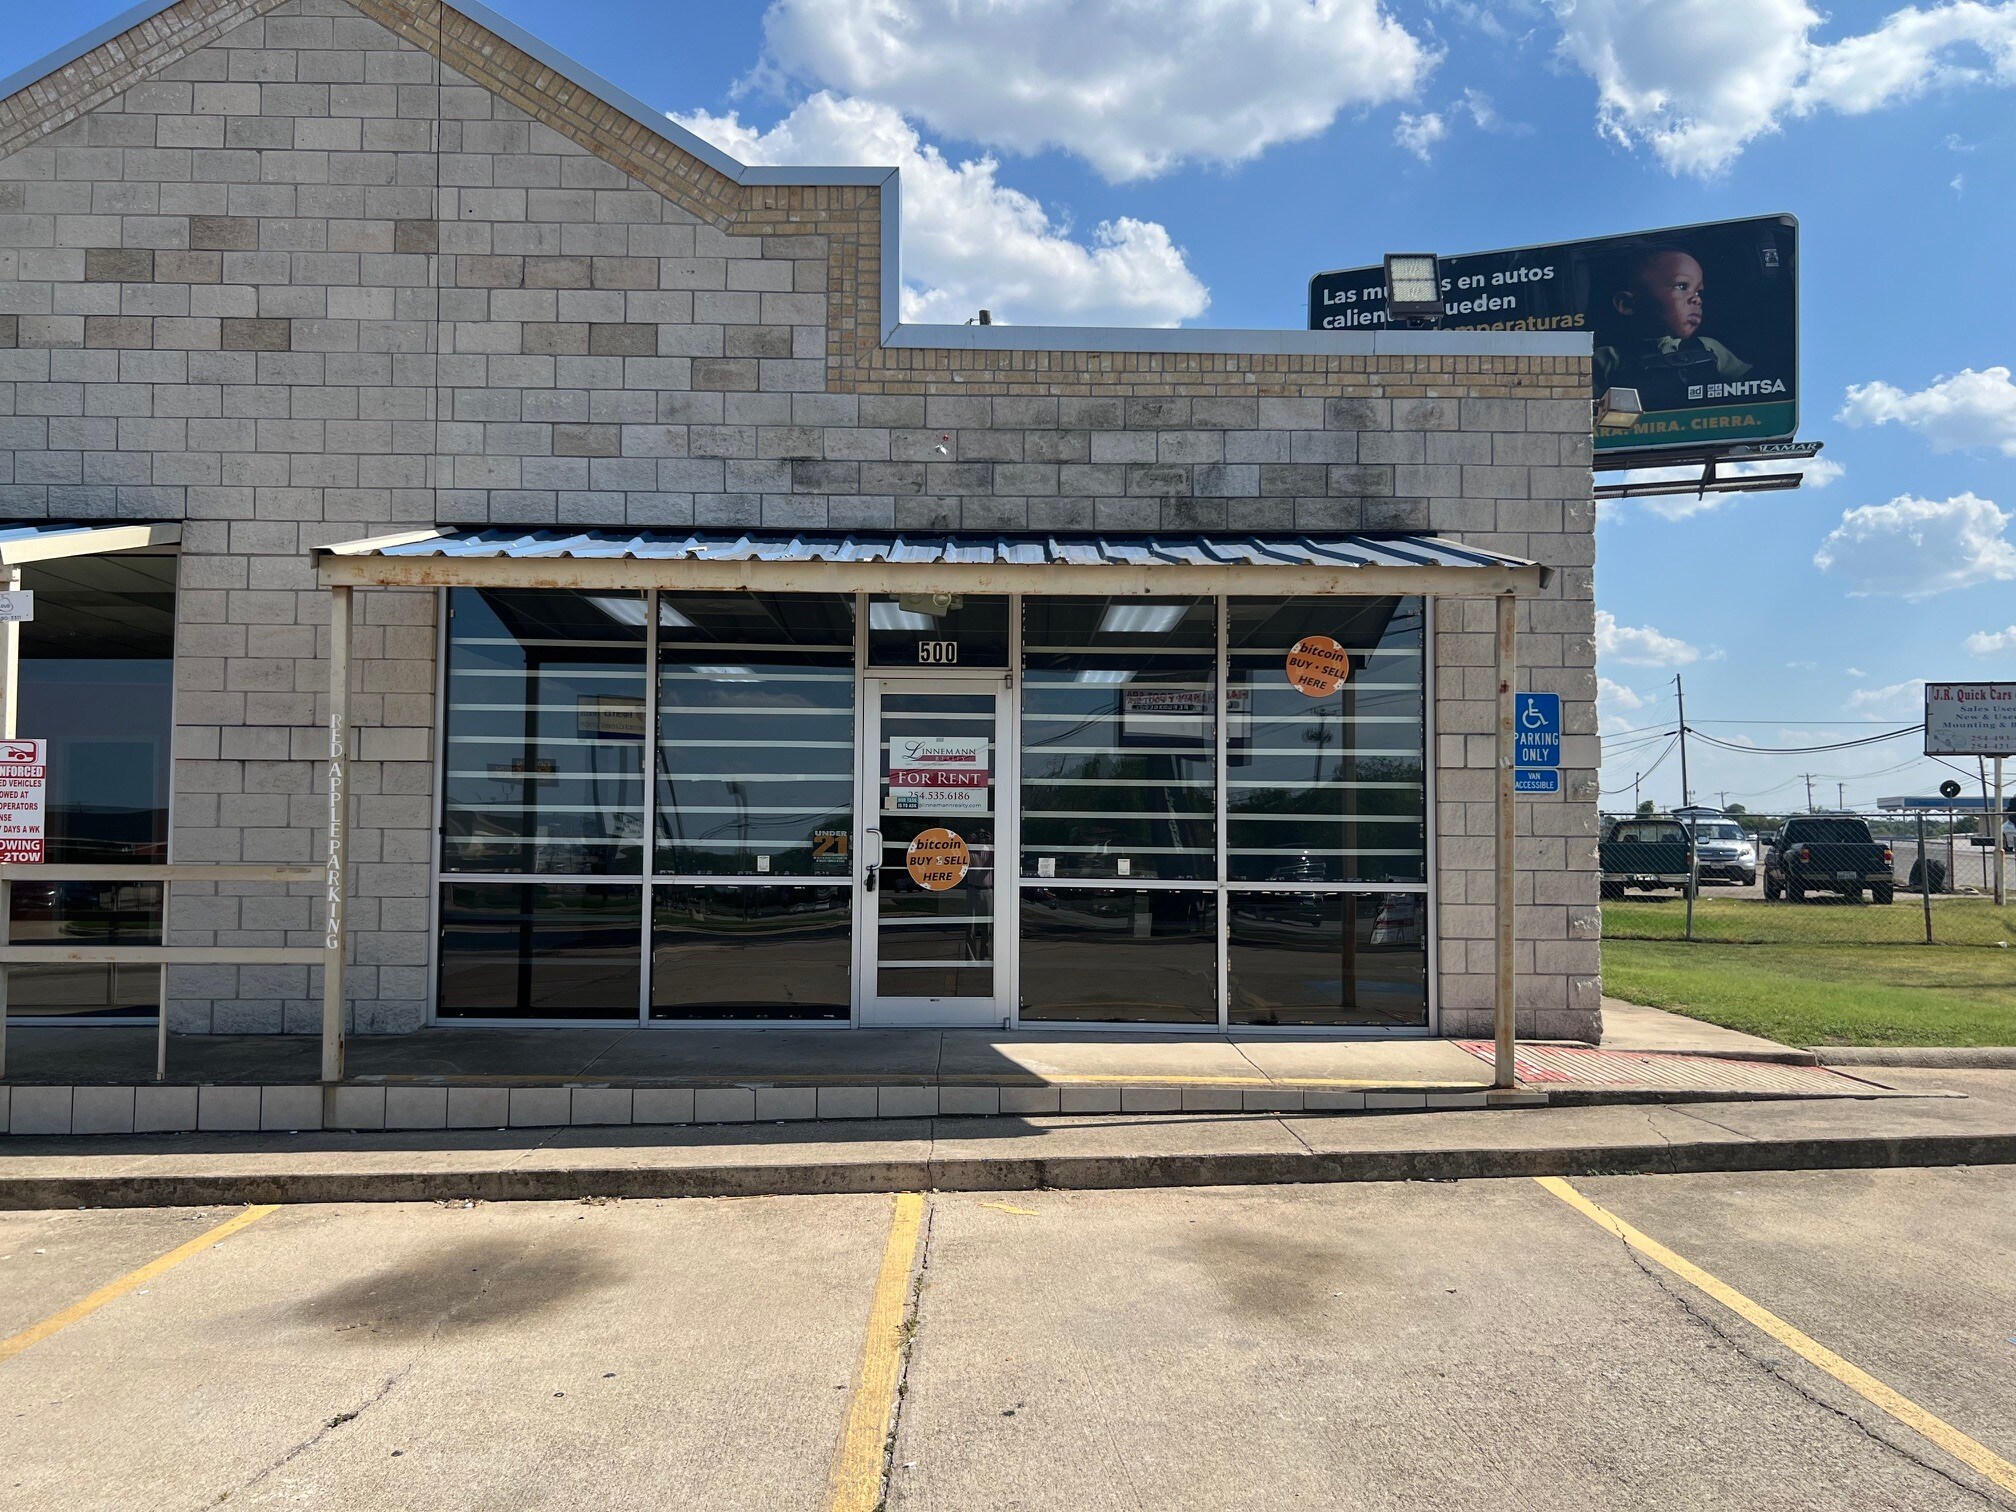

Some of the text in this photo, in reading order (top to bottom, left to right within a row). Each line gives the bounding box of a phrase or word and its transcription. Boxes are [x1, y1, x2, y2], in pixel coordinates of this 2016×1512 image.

[1323, 287, 1357, 305] Las
[1457, 273, 1485, 289] en
[1491, 264, 1555, 286] autos
[1322, 294, 1517, 329] calient ueden
[1432, 313, 1585, 331] eraturas
[1723, 379, 1787, 397] NHTSA
[1593, 414, 1762, 438] ARA. MIRA. CIERRA.
[1760, 443, 1819, 452] LAMAR
[920, 641, 956, 663] 500
[1300, 643, 1344, 662] bitcoin
[1289, 657, 1346, 680] BUY SELL
[1298, 675, 1328, 690] HERE
[1933, 688, 2012, 703] J.R. Quick Cars
[902, 741, 976, 760] LINNEMANN
[1522, 748, 1550, 762] ONLY
[0, 766, 43, 778] NFORCED
[898, 771, 981, 785] FOR RENT
[1528, 772, 1541, 780] VAN
[1515, 781, 1555, 789] ACCESSIBLE
[908, 791, 970, 800] 254.535.6186
[29, 826, 40, 834] WK
[326, 713, 343, 949] RED APPLE PARKING
[0, 840, 40, 850] OWING
[812, 836, 848, 856] 21
[916, 839, 961, 850] bitcoin
[0, 852, 41, 862] -2TOW
[909, 856, 968, 866] BUY SELL
[923, 872, 953, 882] HERE
